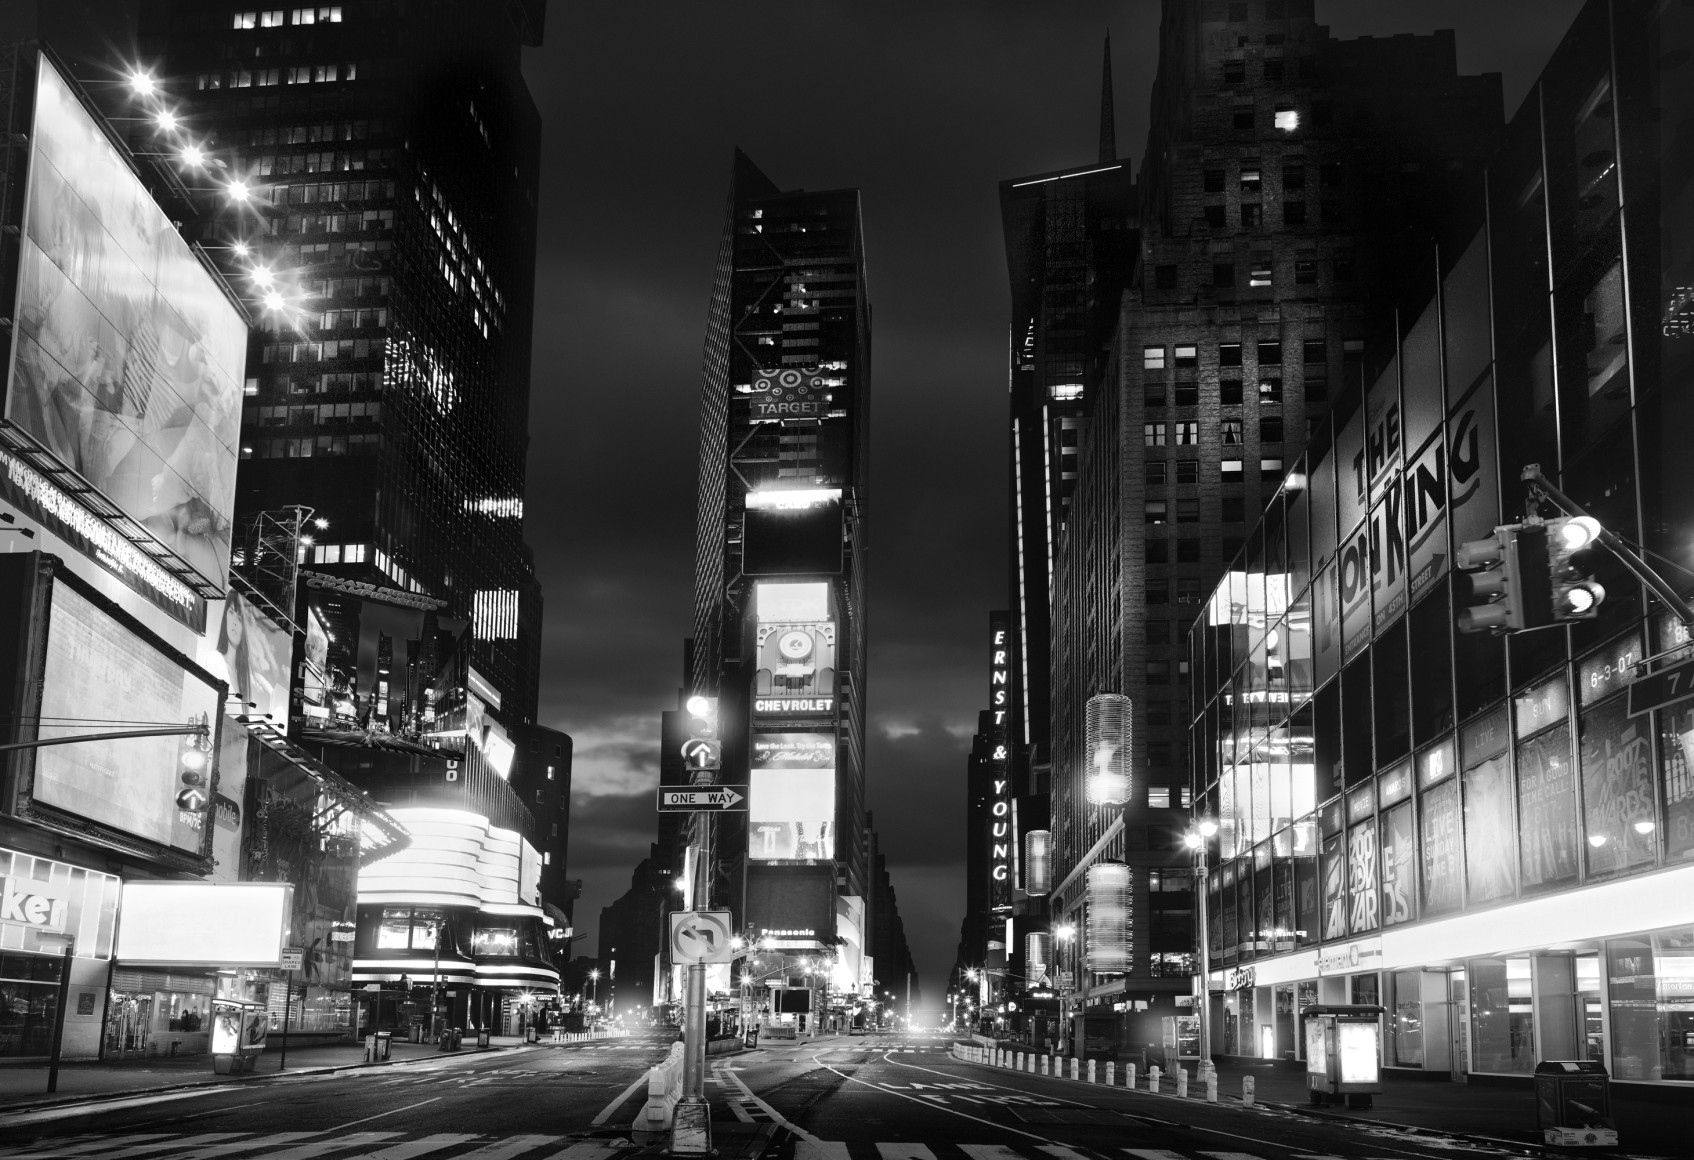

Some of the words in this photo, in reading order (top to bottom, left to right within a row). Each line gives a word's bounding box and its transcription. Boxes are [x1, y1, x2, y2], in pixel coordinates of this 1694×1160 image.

[758, 401, 822, 414] TARGET
[1353, 402, 1399, 497] THE
[1384, 410, 1480, 588] KING
[1345, 624, 1370, 655] ENTRANCE
[1376, 612, 1386, 626] ON
[1388, 592, 1404, 615] 45TH
[1411, 565, 1432, 594] STREET
[993, 630, 1007, 725] ERNST
[1591, 652, 1632, 688] 6-3-07
[755, 699, 833, 712] CHEVROLET
[1533, 697, 1551, 718] SUN
[1475, 727, 1495, 748] LIVE
[993, 745, 1007, 760] &
[1522, 775, 1537, 791] FOR
[1546, 762, 1569, 782] GOOD
[671, 793, 696, 804] ONE
[708, 793, 735, 803] WAY
[993, 780, 1007, 881] YOUNG
[1425, 812, 1454, 842] LIVE
[761, 928, 815, 936] Panasonic
